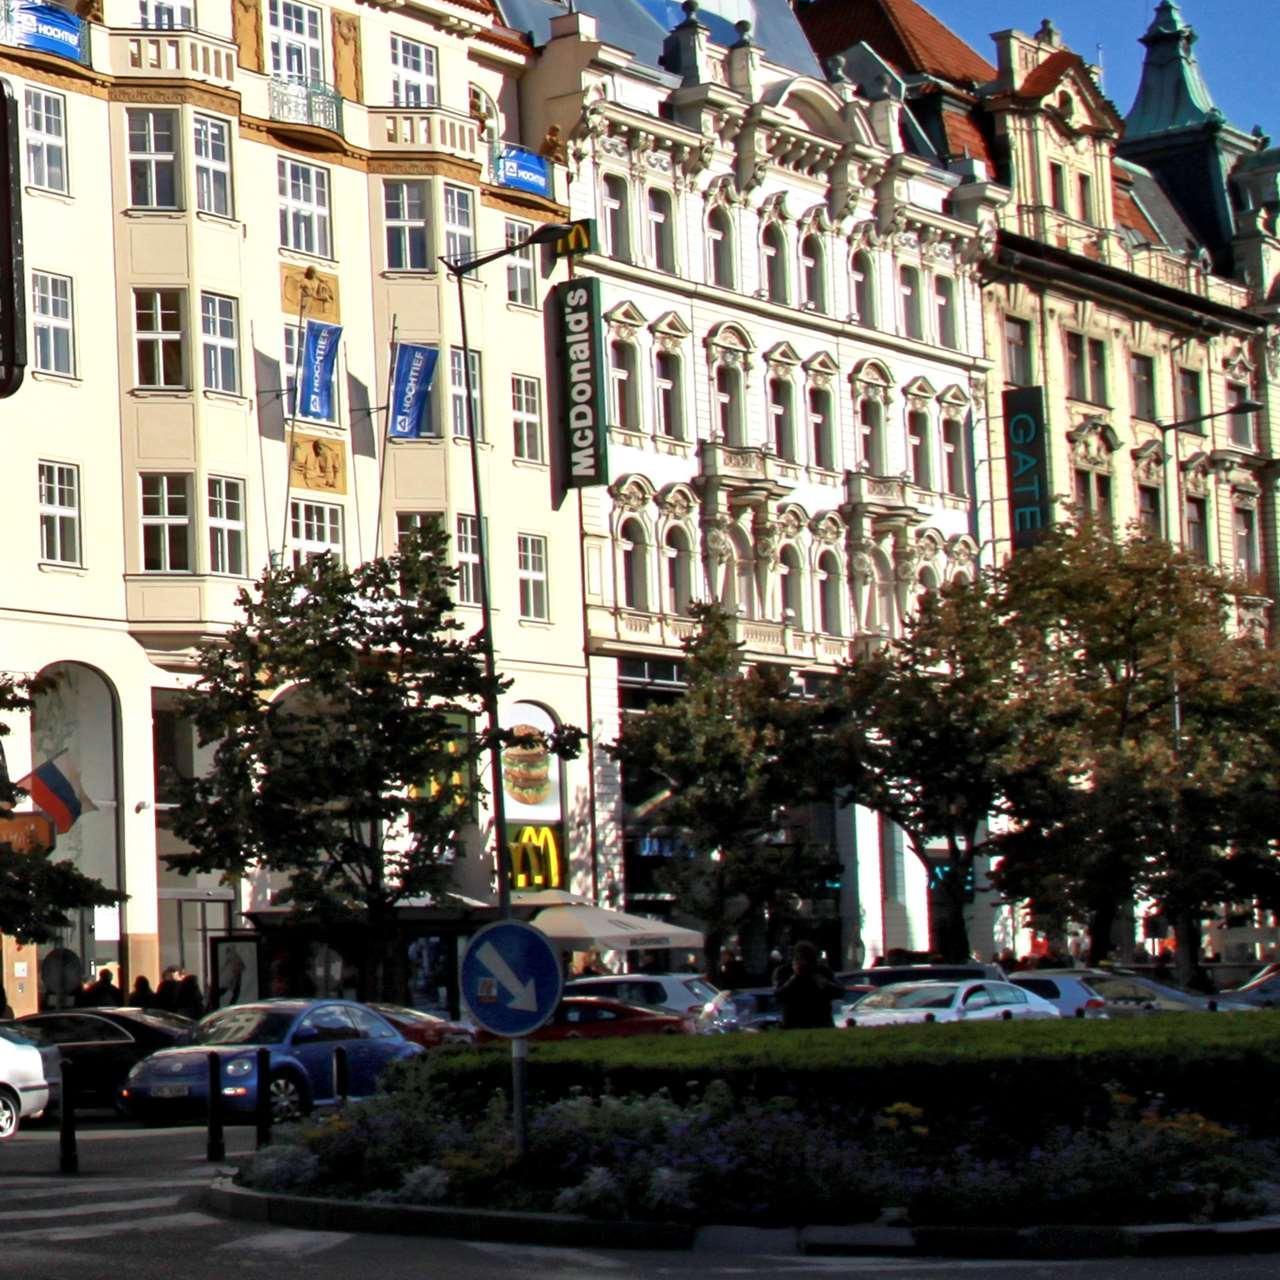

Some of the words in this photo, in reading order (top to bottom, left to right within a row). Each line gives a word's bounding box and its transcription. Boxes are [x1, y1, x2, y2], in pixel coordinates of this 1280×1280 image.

[312, 328, 330, 393] HOCHTIEF
[402, 350, 425, 414] HOCHTIEF
[564, 287, 598, 478] McDonald's
[1010, 413, 1042, 531] GATE
